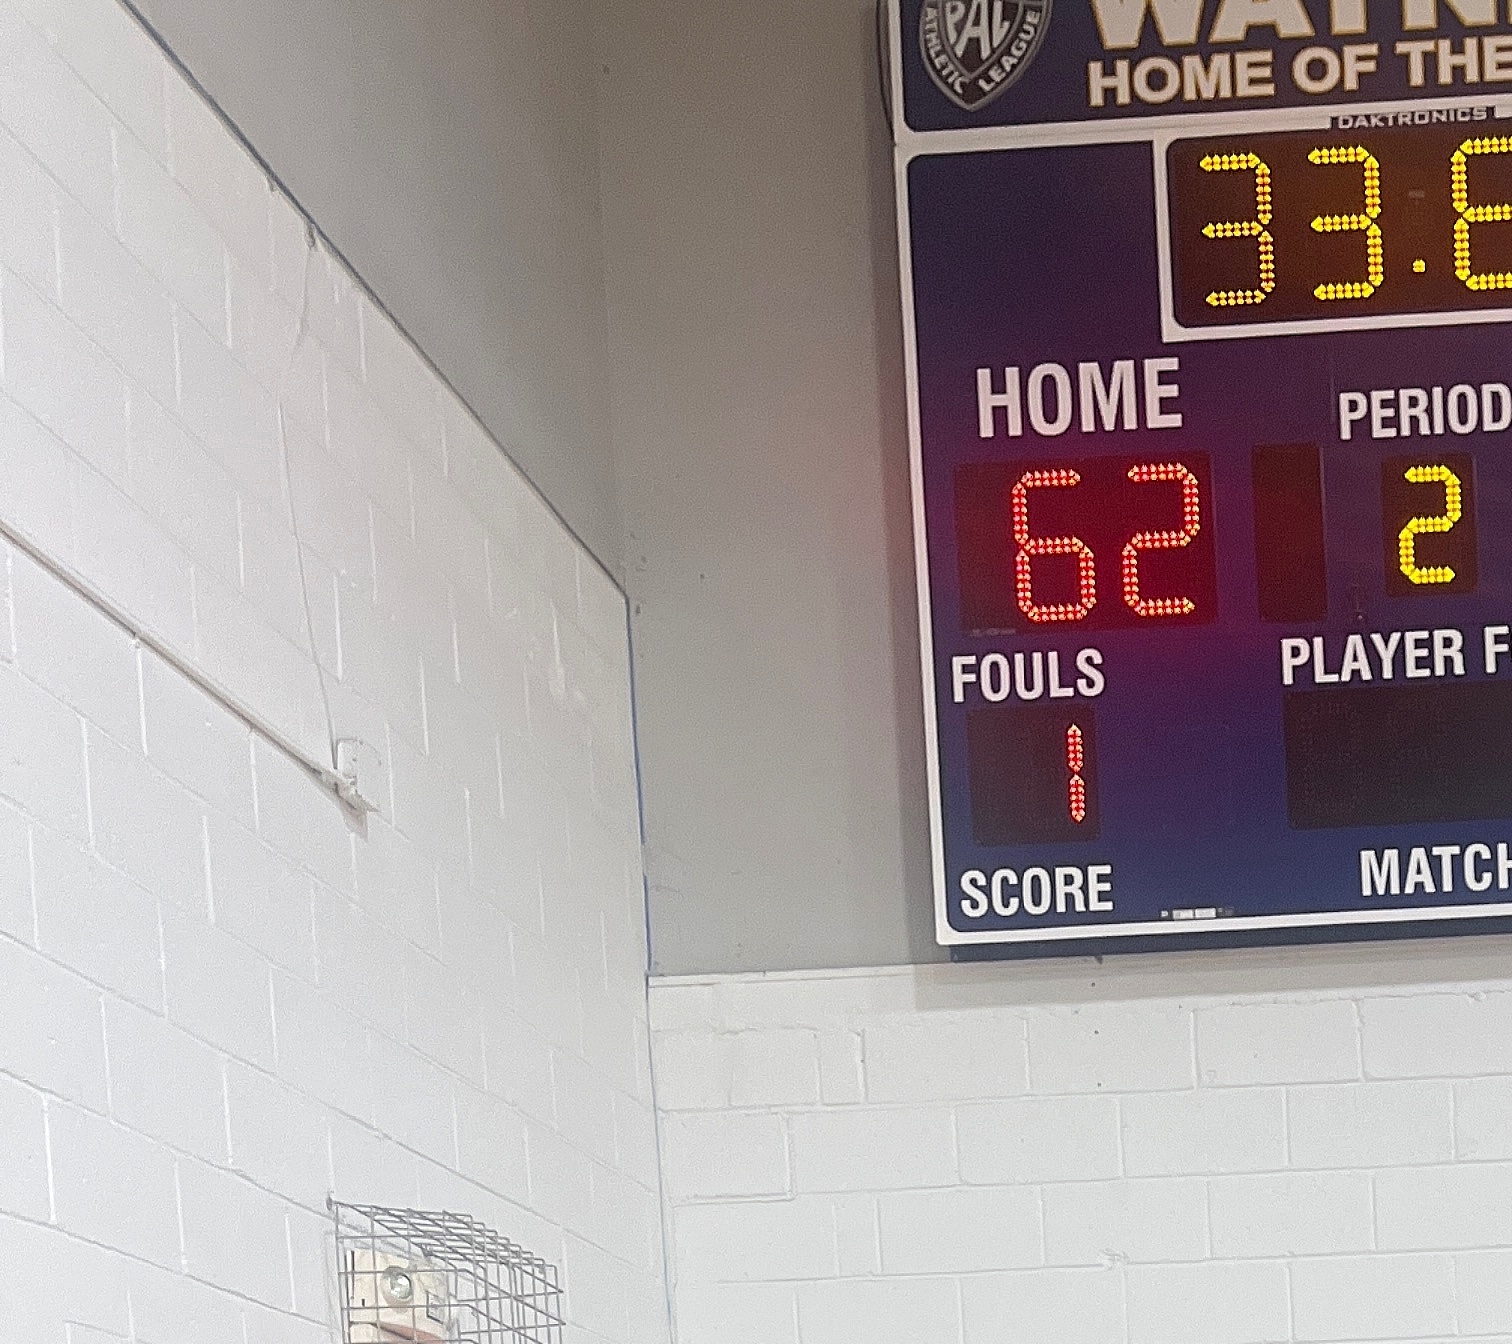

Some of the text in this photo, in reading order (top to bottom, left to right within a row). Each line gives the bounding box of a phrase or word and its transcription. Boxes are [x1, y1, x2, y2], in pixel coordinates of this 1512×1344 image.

[925, 7, 970, 94] ATHLETIC
[978, 10, 1040, 92] LEAGUE
[1088, 49, 1275, 107] HOME
[1292, 44, 1379, 93] OF
[1338, 107, 1487, 129] DAKTRONICS
[977, 357, 1182, 437] HOME
[1339, 383, 1512, 440] PERIOD
[1011, 461, 1201, 623] 62
[1399, 465, 1462, 584] 2
[951, 649, 1105, 703] FOULS
[1281, 629, 1465, 685] PLAYER
[1067, 722, 1085, 822] 1
[960, 864, 1114, 918] SCORE
